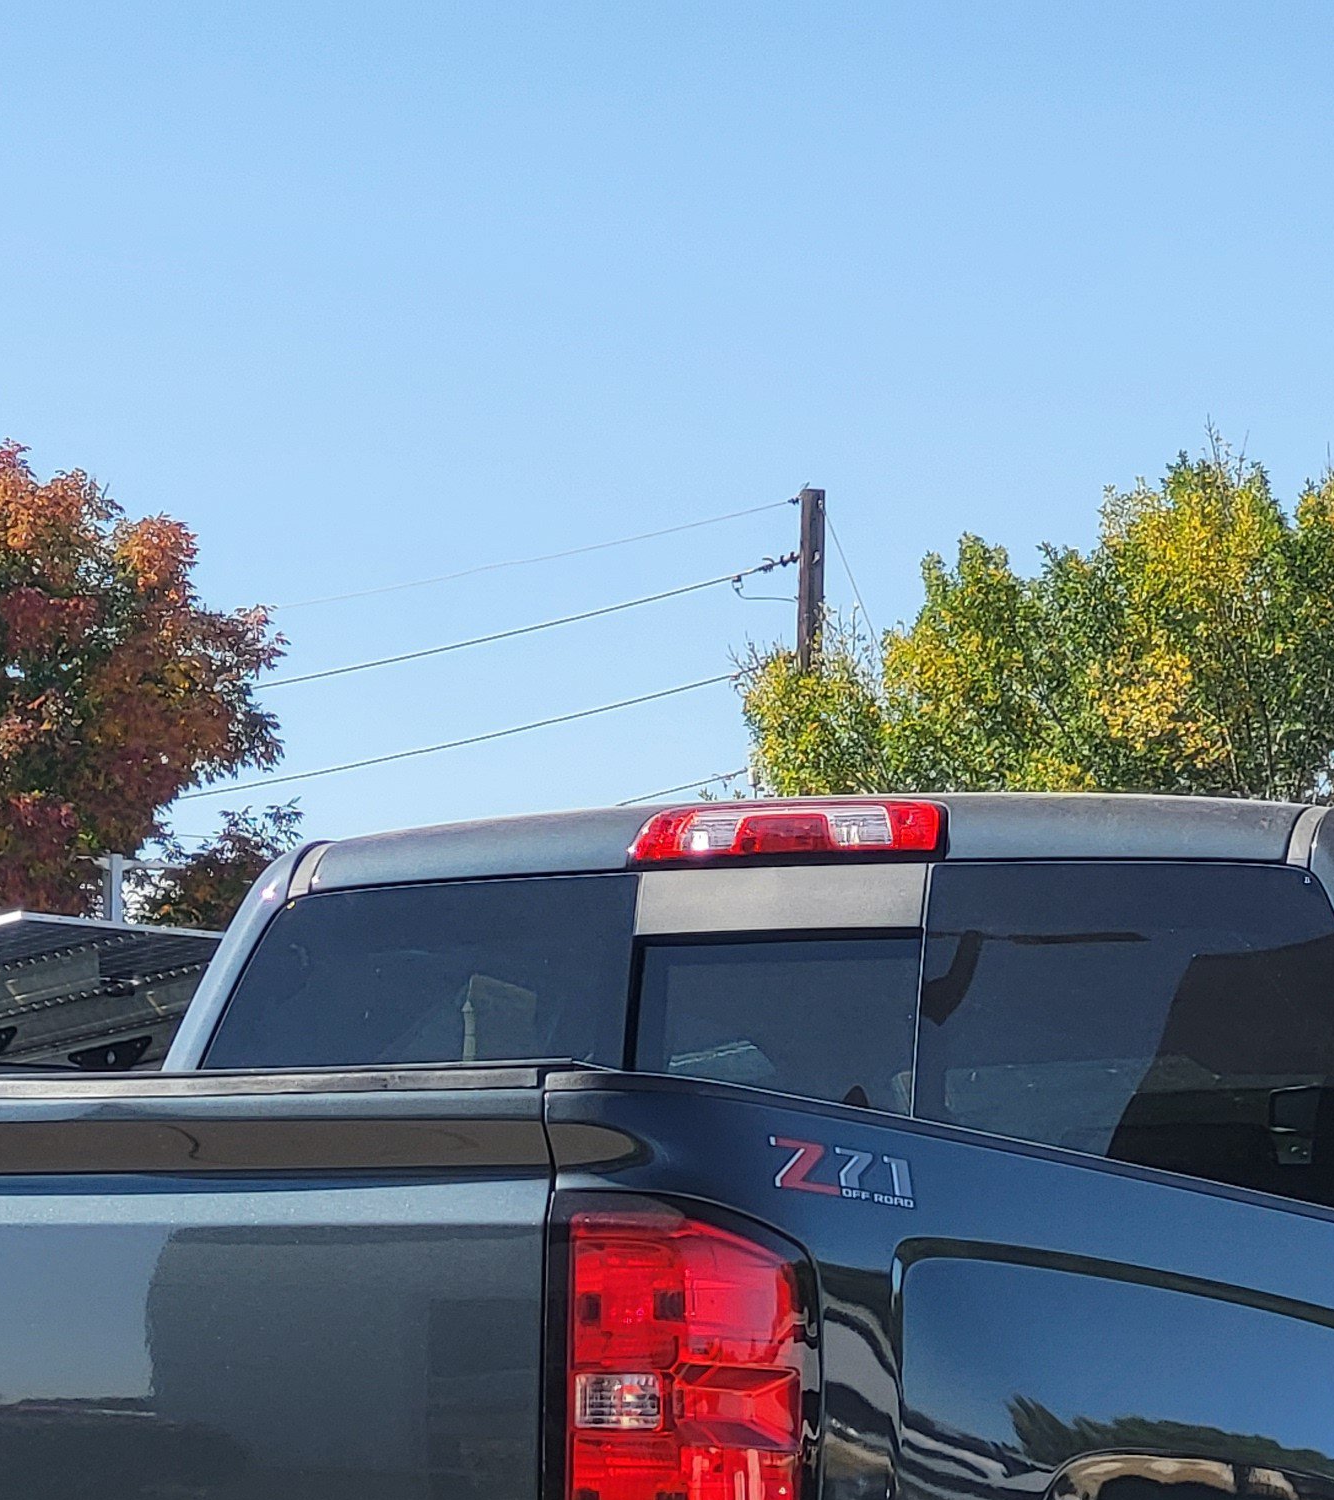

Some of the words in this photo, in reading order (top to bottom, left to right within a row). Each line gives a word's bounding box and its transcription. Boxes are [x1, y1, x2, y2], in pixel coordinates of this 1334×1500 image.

[769, 1135, 914, 1198] Z71
[841, 1187, 871, 1201] OFF
[873, 1192, 915, 1209] ROAD
